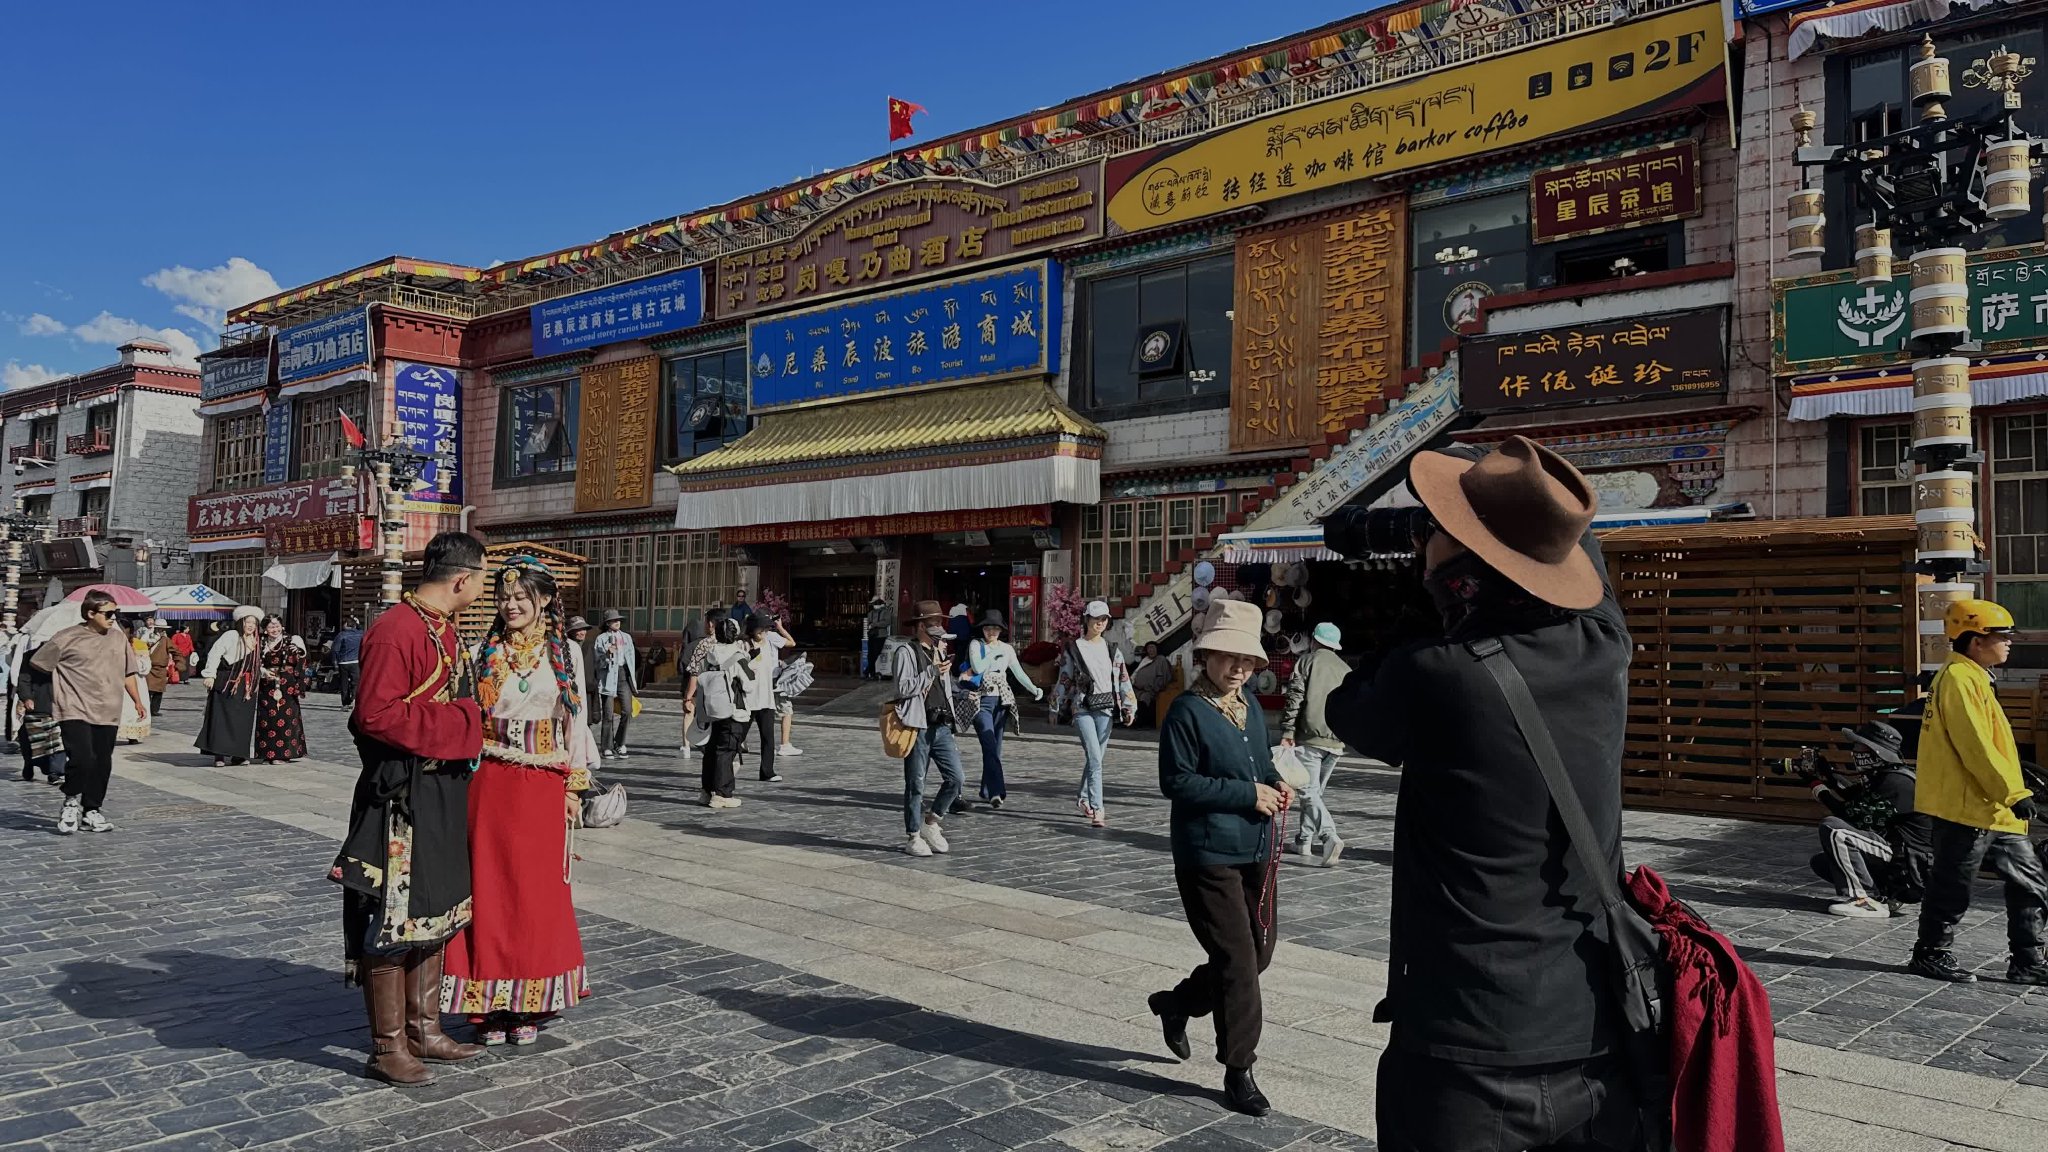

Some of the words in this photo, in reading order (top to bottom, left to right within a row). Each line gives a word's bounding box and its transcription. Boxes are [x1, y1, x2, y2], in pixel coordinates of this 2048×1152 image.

[1643, 30, 1706, 74] 2F
[1222, 142, 1387, 201] 转经道咖啡馆
[1395, 128, 1456, 155] barkor
[1463, 109, 1530, 143] coffee
[1557, 181, 1674, 222] 星辰茶馆
[794, 226, 988, 294] 岗嘎乃曲酒店
[542, 293, 686, 339] 尼桑辰波商场二楼古玩城
[561, 337, 573, 347] The
[574, 331, 596, 343] second
[781, 310, 1036, 378] 尼桑辰波旅游商城
[875, 371, 891, 381] Chen
[940, 359, 963, 369] Tourist
[979, 353, 996, 363] Mall
[1303, 479, 1350, 521] 各式茶饮
[1144, 592, 1192, 636] 请上
